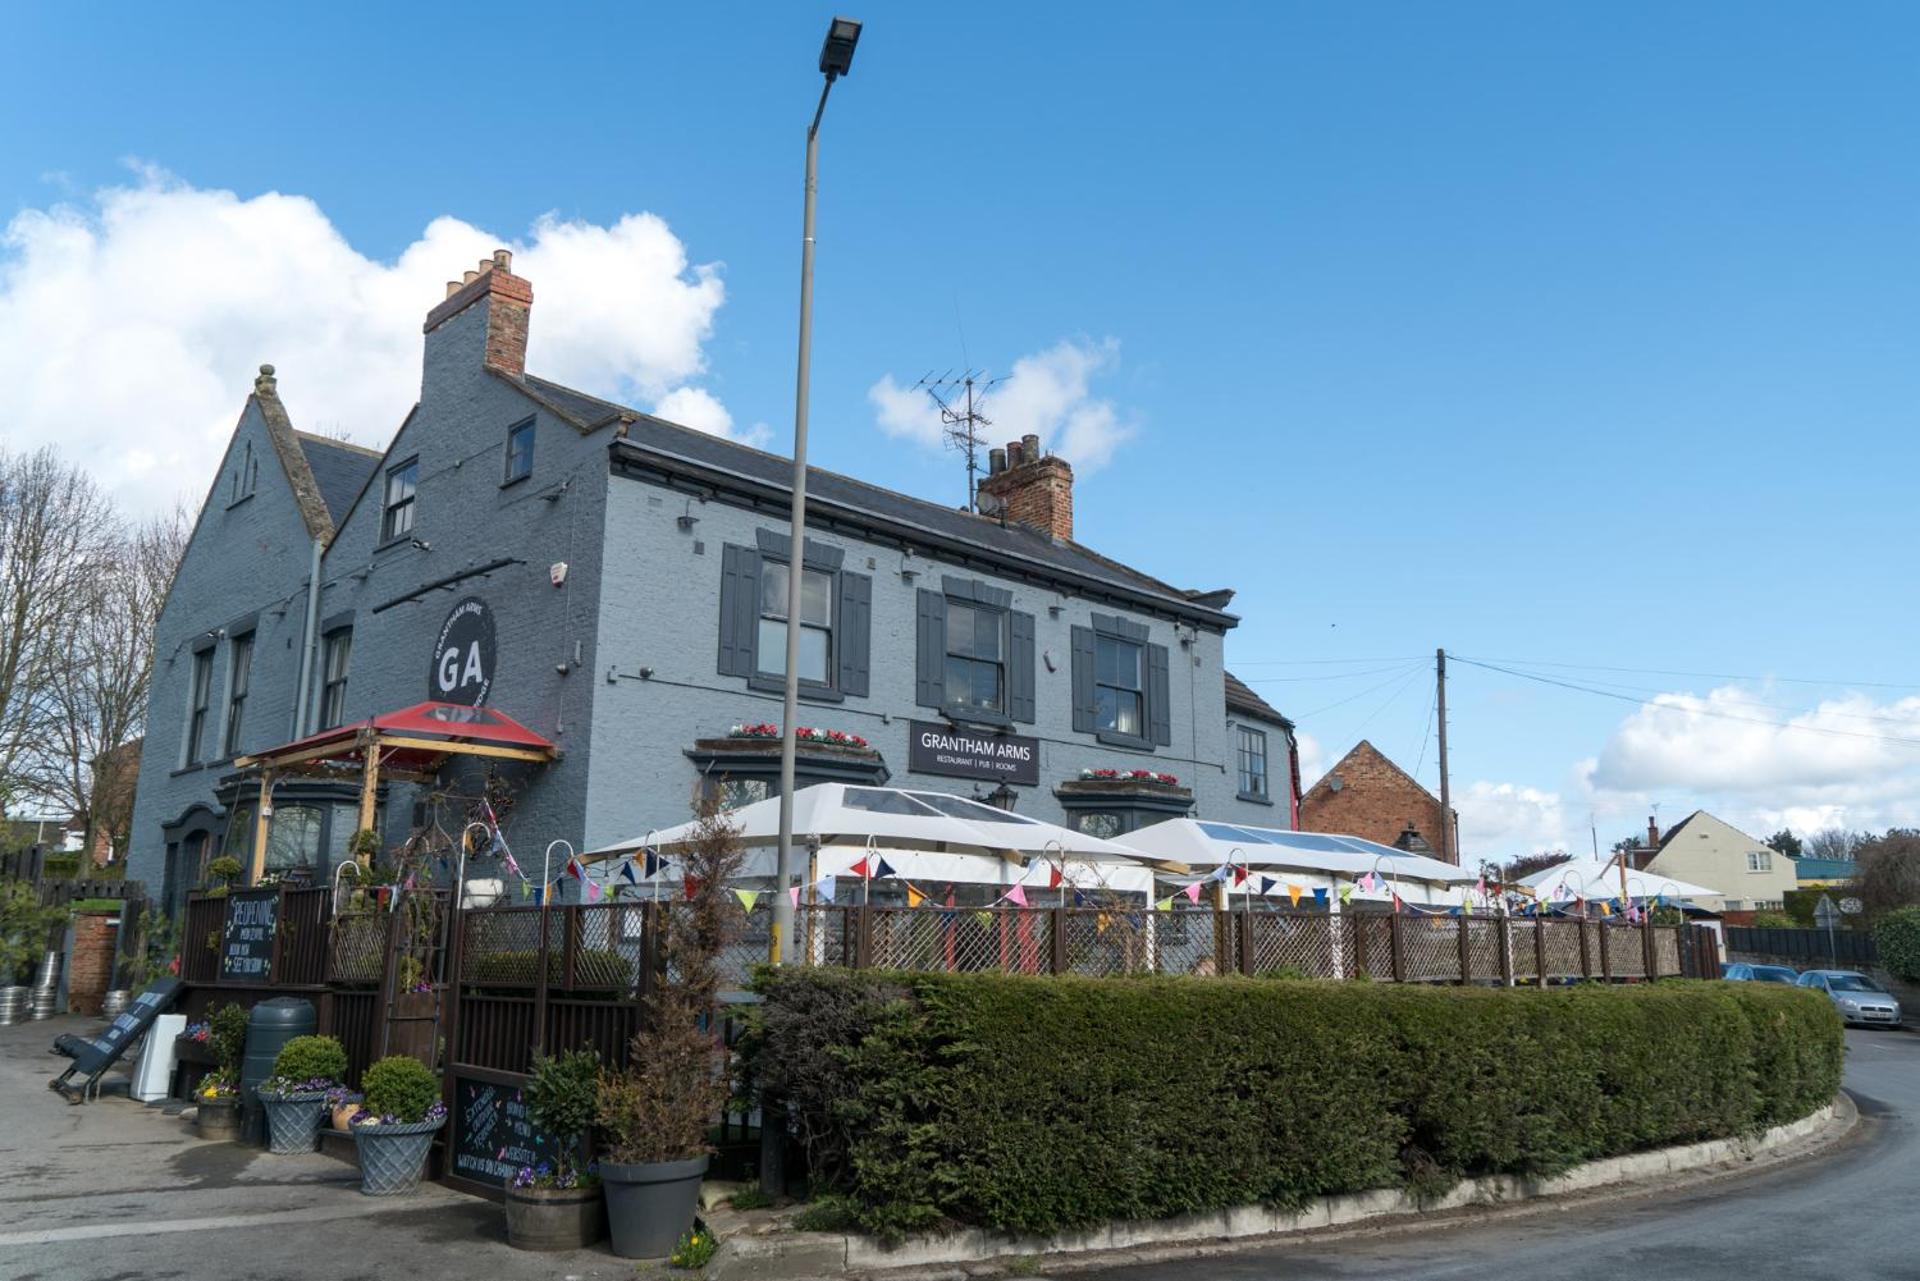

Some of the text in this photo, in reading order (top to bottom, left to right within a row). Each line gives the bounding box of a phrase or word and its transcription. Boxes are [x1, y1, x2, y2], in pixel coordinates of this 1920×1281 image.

[435, 604, 465, 659] GRANTHAM
[438, 640, 483, 692] GA
[921, 732, 1031, 761] GRANTHAM ARMS
[936, 754, 1017, 772] RESTAURANT PUB ROOMS
[234, 901, 272, 925] REOPENING
